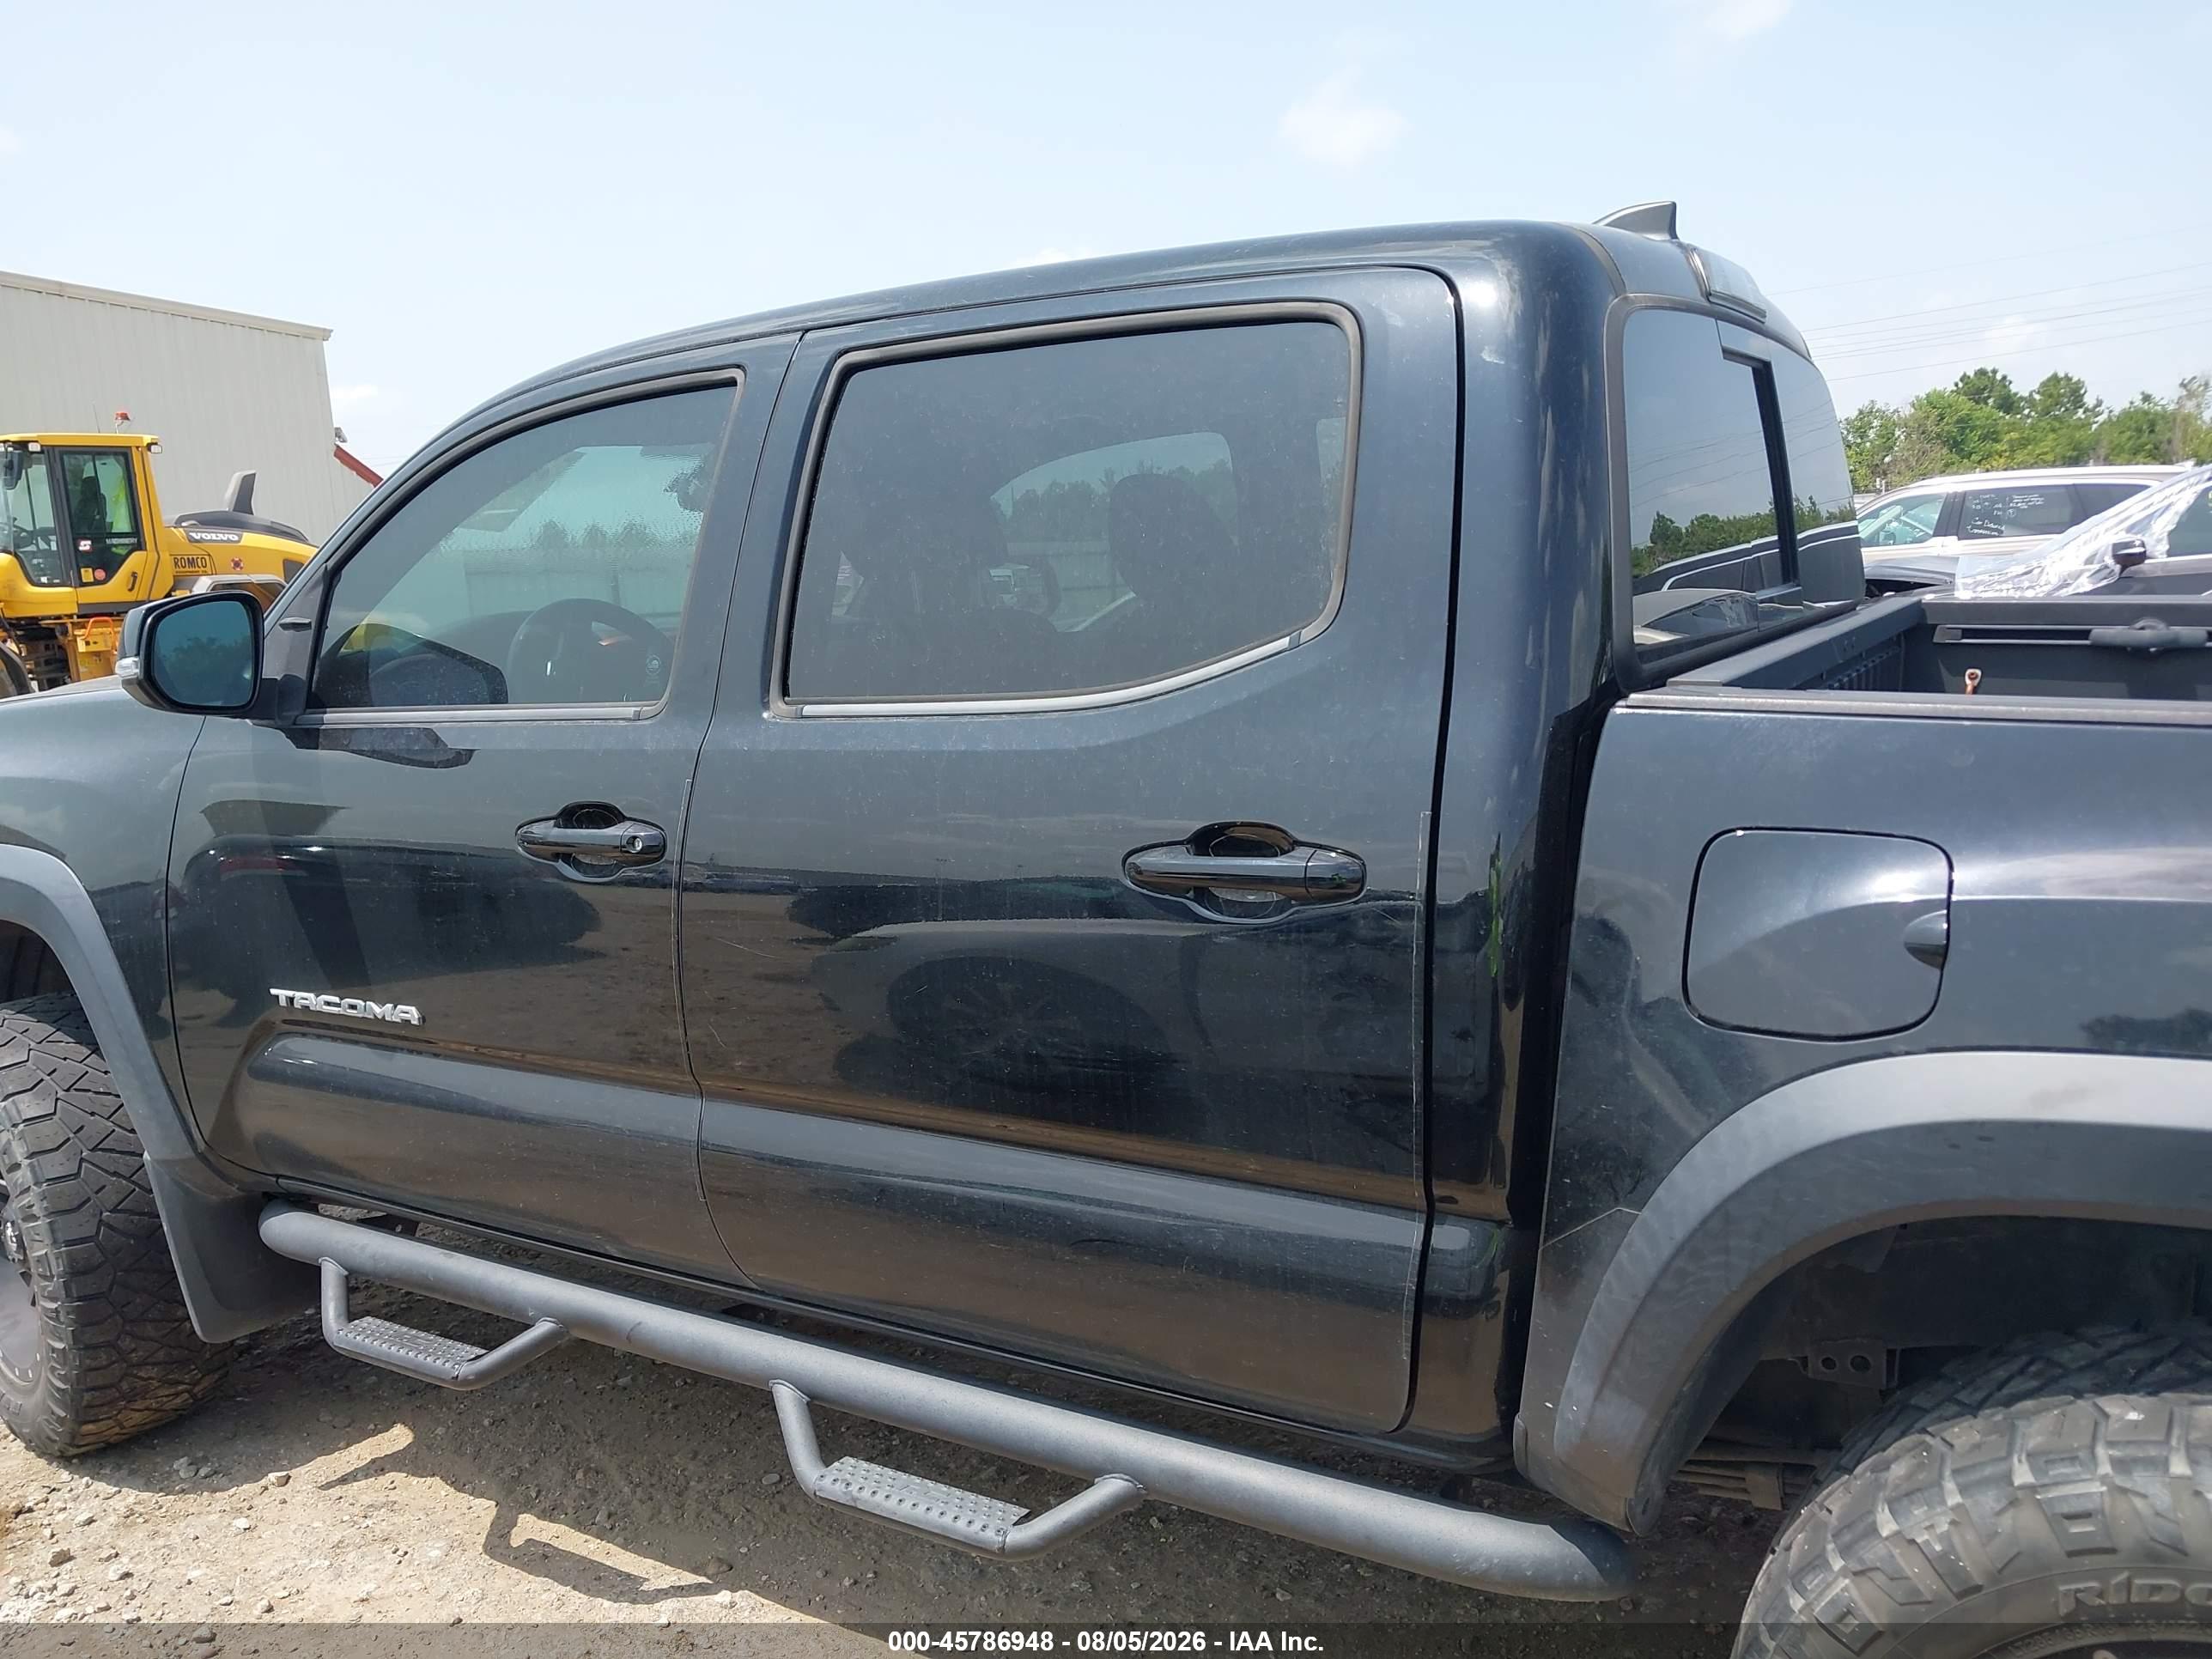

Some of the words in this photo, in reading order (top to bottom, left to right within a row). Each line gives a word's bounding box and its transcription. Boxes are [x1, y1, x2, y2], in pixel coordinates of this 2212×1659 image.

[189, 532, 240, 541] VOLVO
[173, 556, 208, 569] ROMCO
[270, 988, 424, 1026] TACOMA
